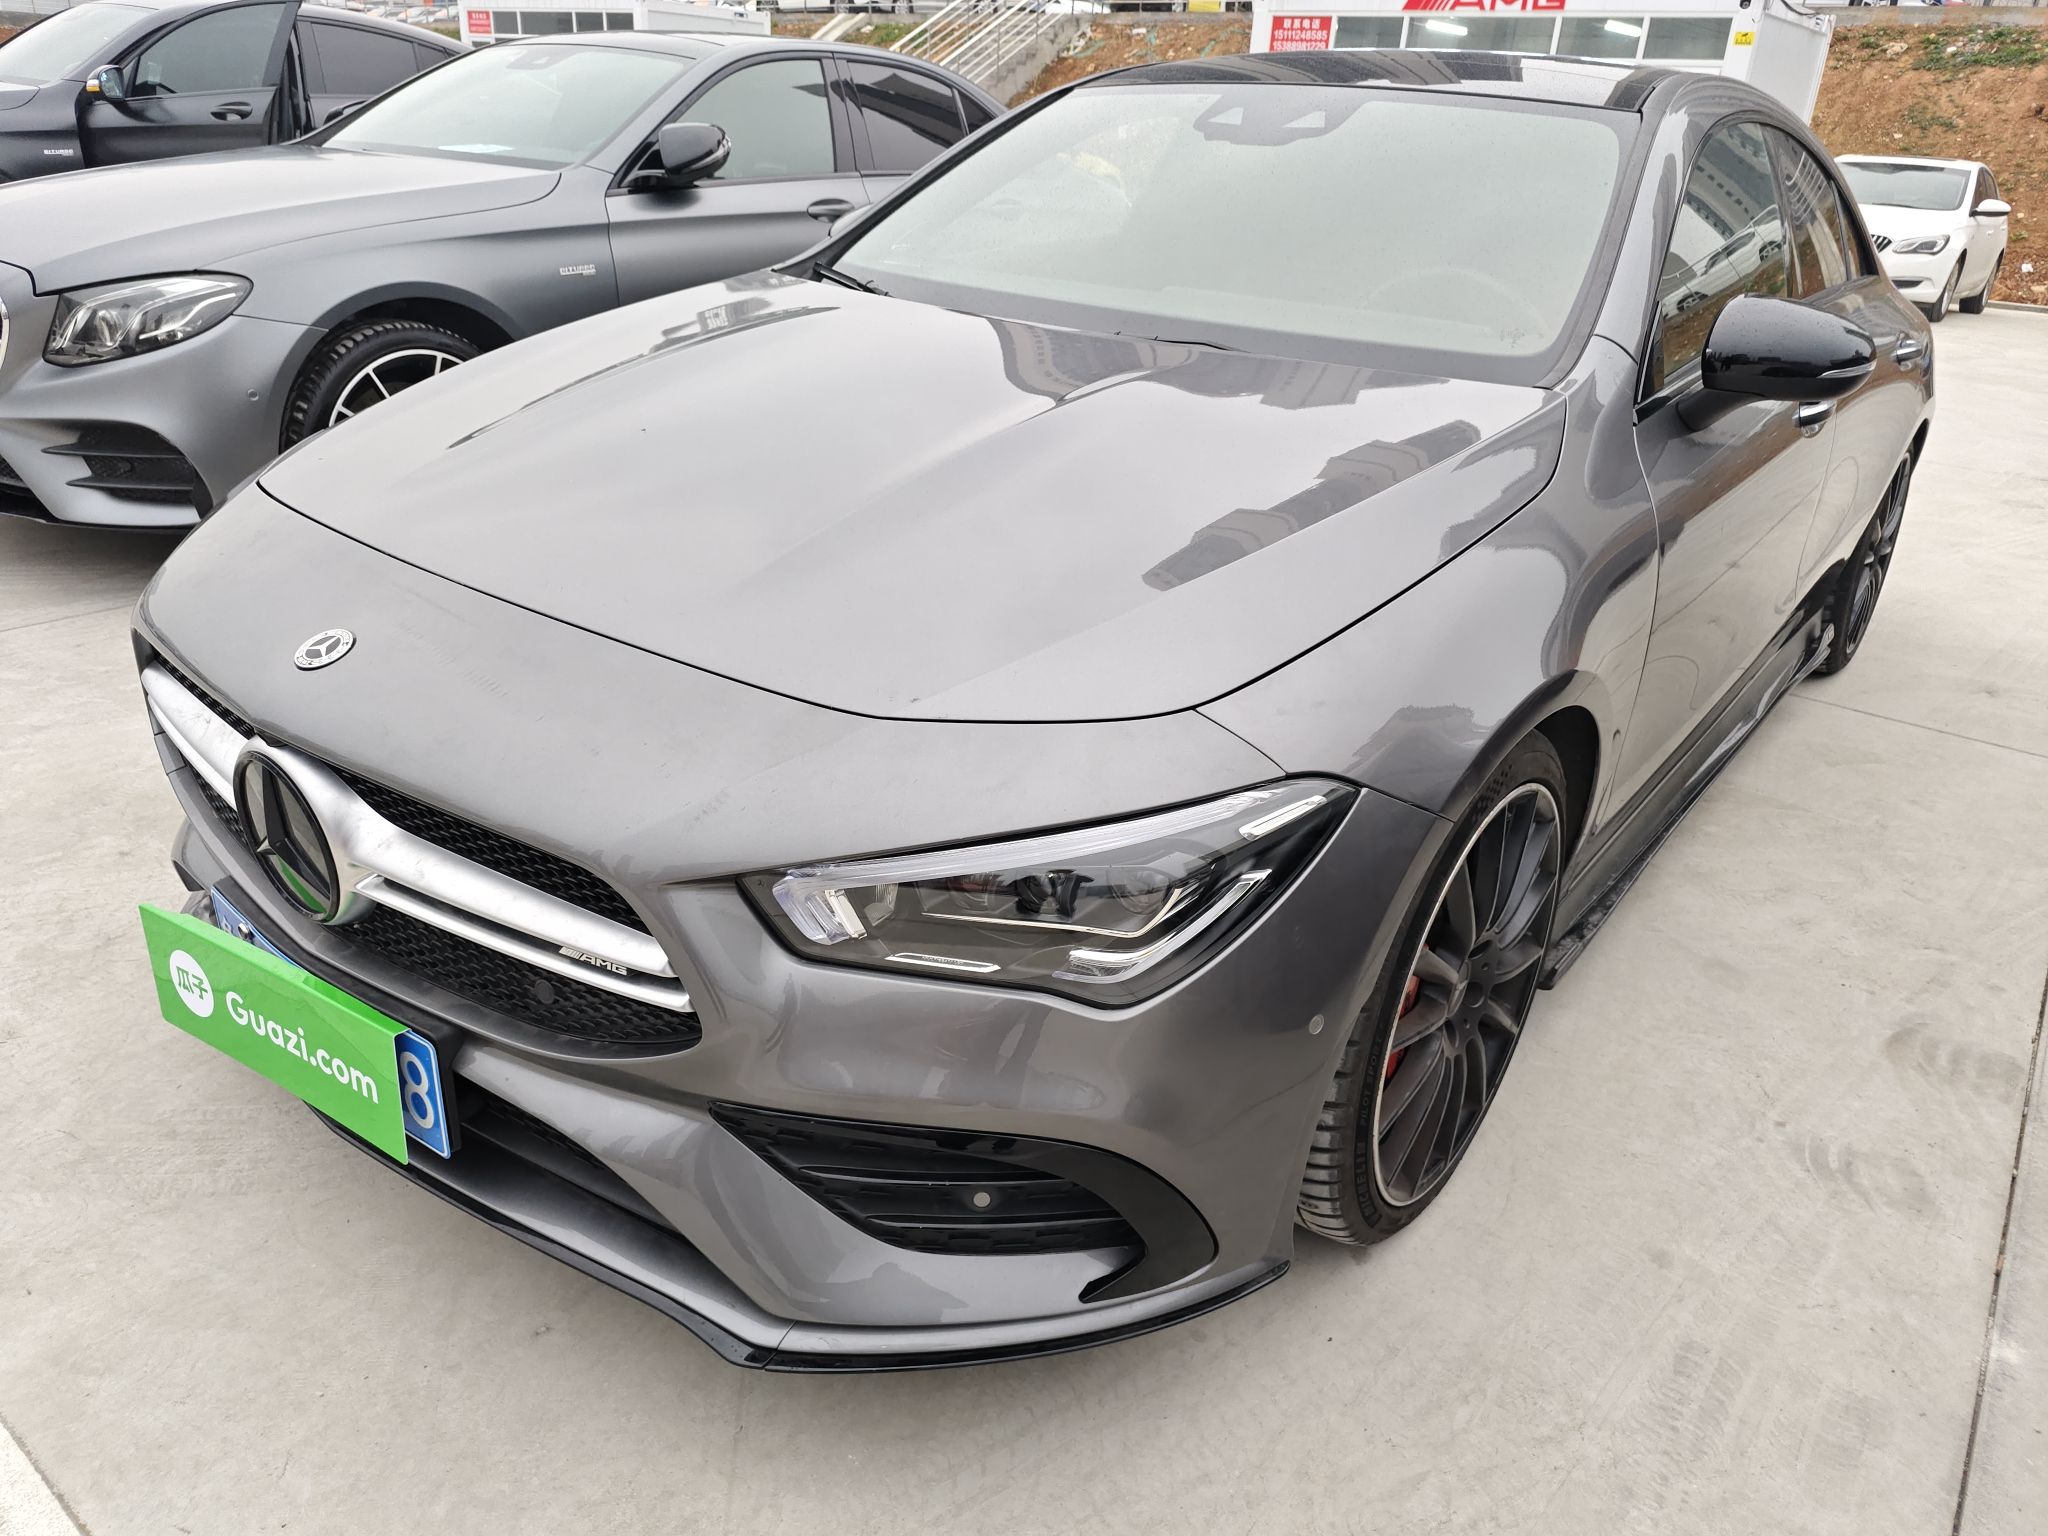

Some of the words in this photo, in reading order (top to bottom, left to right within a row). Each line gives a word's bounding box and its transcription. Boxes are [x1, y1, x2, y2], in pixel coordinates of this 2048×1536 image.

[1273, 29, 1328, 40] 15111248585
[579, 952, 628, 976] AMG
[176, 966, 208, 1000] 瓜子
[226, 991, 379, 1104] Guazi.com
[400, 1051, 434, 1130] 8
